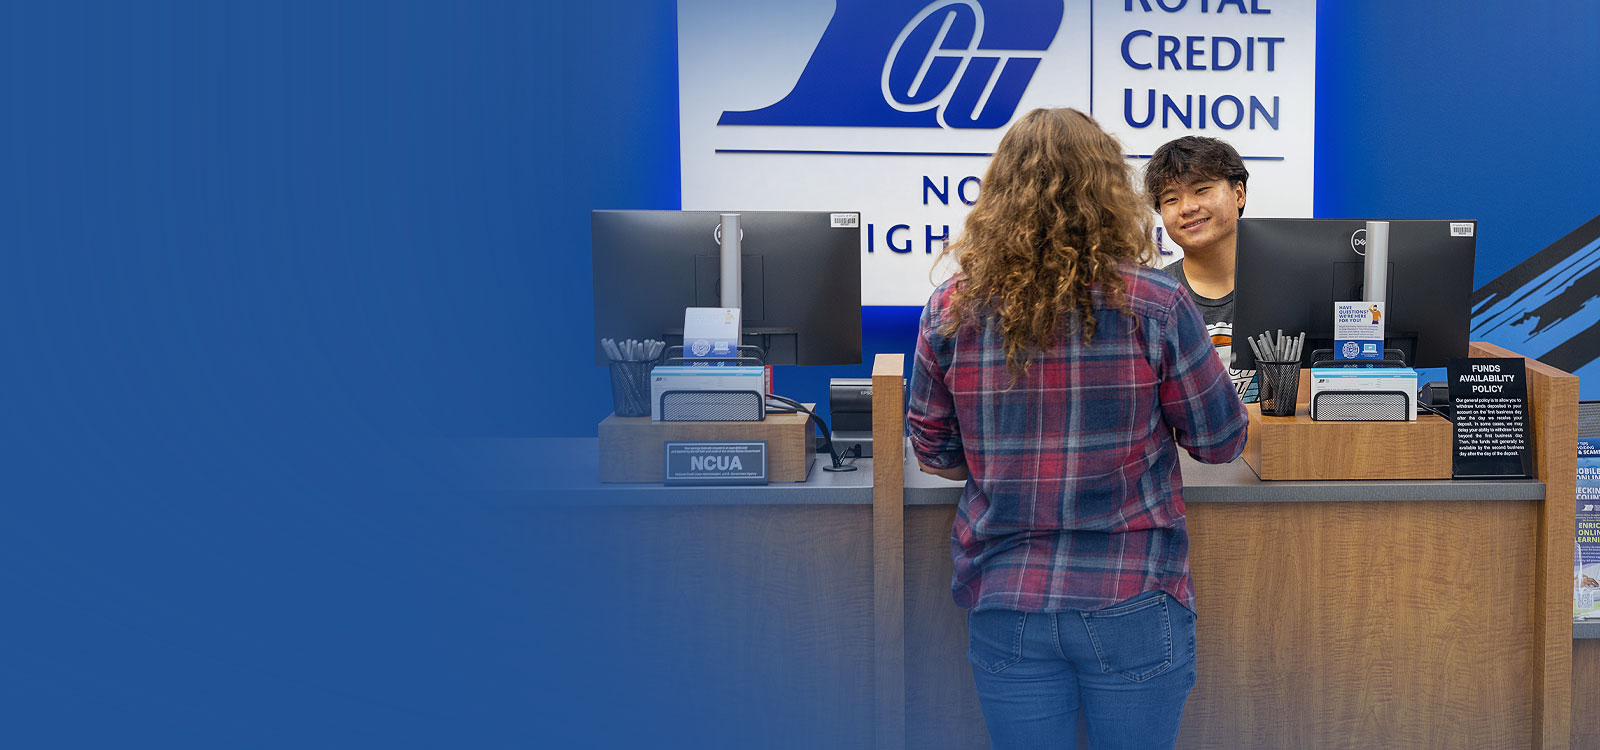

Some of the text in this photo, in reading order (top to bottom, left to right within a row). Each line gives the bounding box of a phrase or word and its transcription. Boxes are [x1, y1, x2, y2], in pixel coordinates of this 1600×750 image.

[1121, 30, 1285, 72] CREDIT
[1124, 88, 1280, 131] UNION
[923, 176, 981, 206] NO
[867, 224, 949, 254] IGH
[691, 455, 742, 471] NCUA
